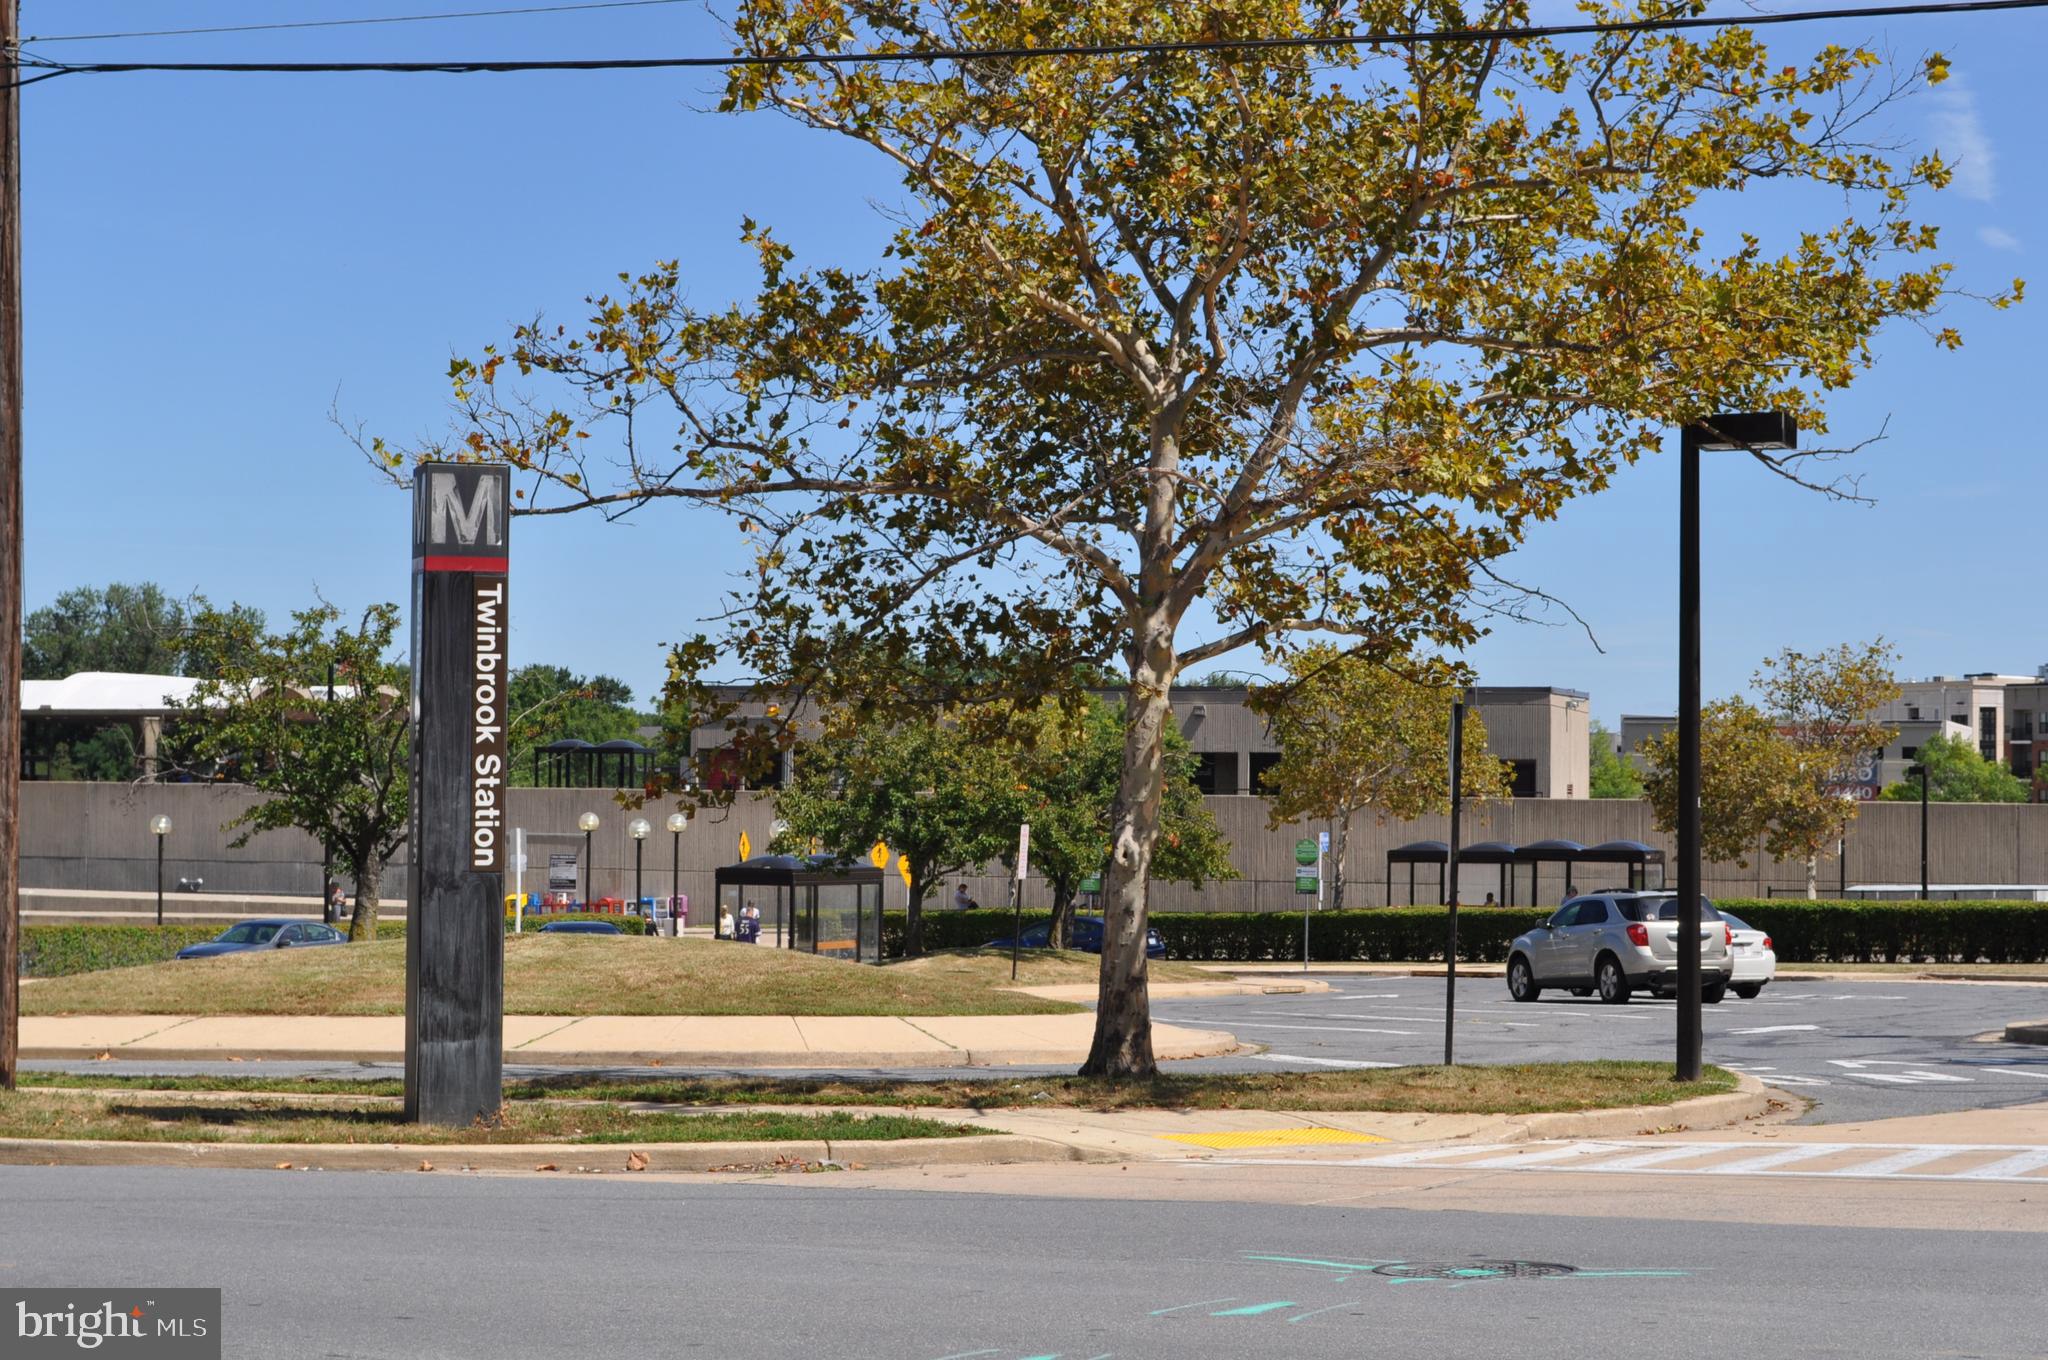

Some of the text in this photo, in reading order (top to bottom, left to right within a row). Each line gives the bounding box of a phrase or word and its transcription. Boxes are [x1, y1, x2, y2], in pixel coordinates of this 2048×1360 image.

[431, 472, 502, 545] M
[474, 583, 502, 867] Twinbrook Station
